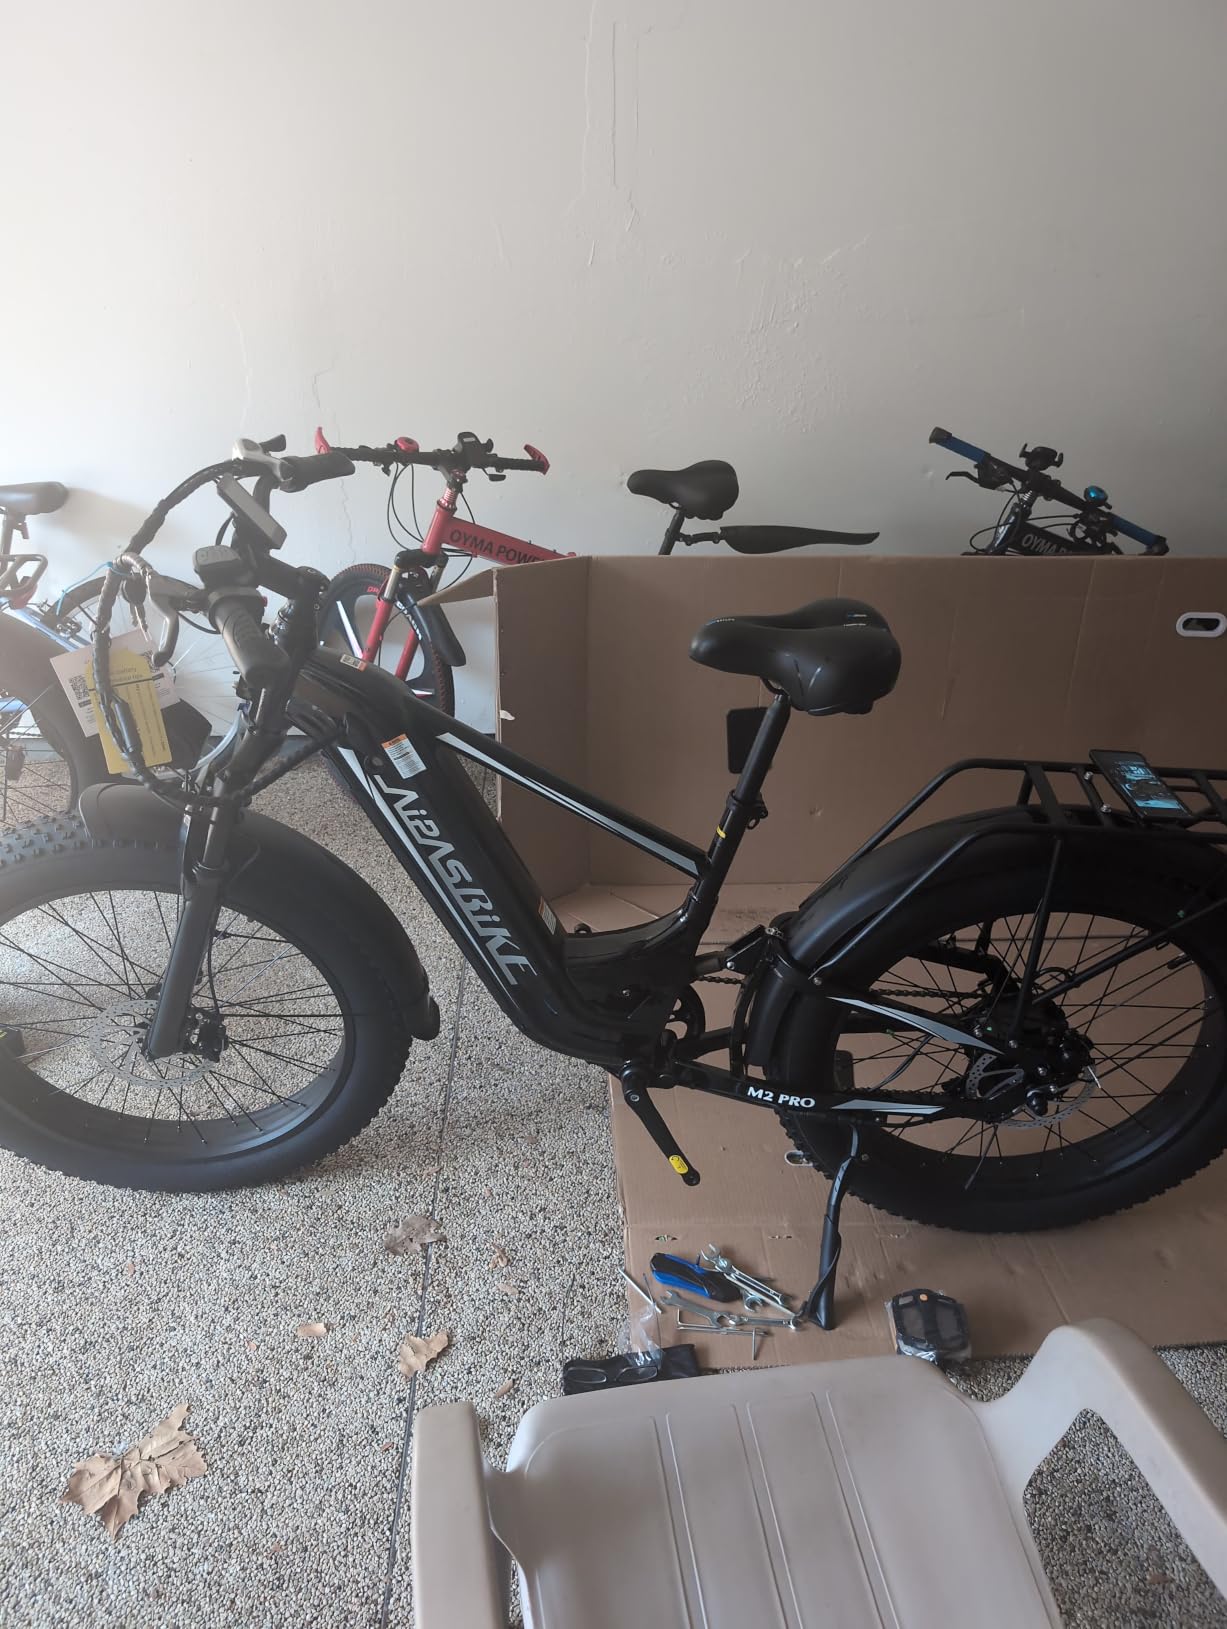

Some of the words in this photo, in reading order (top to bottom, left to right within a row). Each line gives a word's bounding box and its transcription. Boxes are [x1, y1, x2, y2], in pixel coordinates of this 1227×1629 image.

[450, 529, 493, 555] OYMA
[1021, 534, 1058, 553] OYMA
[747, 1086, 774, 1102] M2
[778, 1093, 816, 1108] PRO
